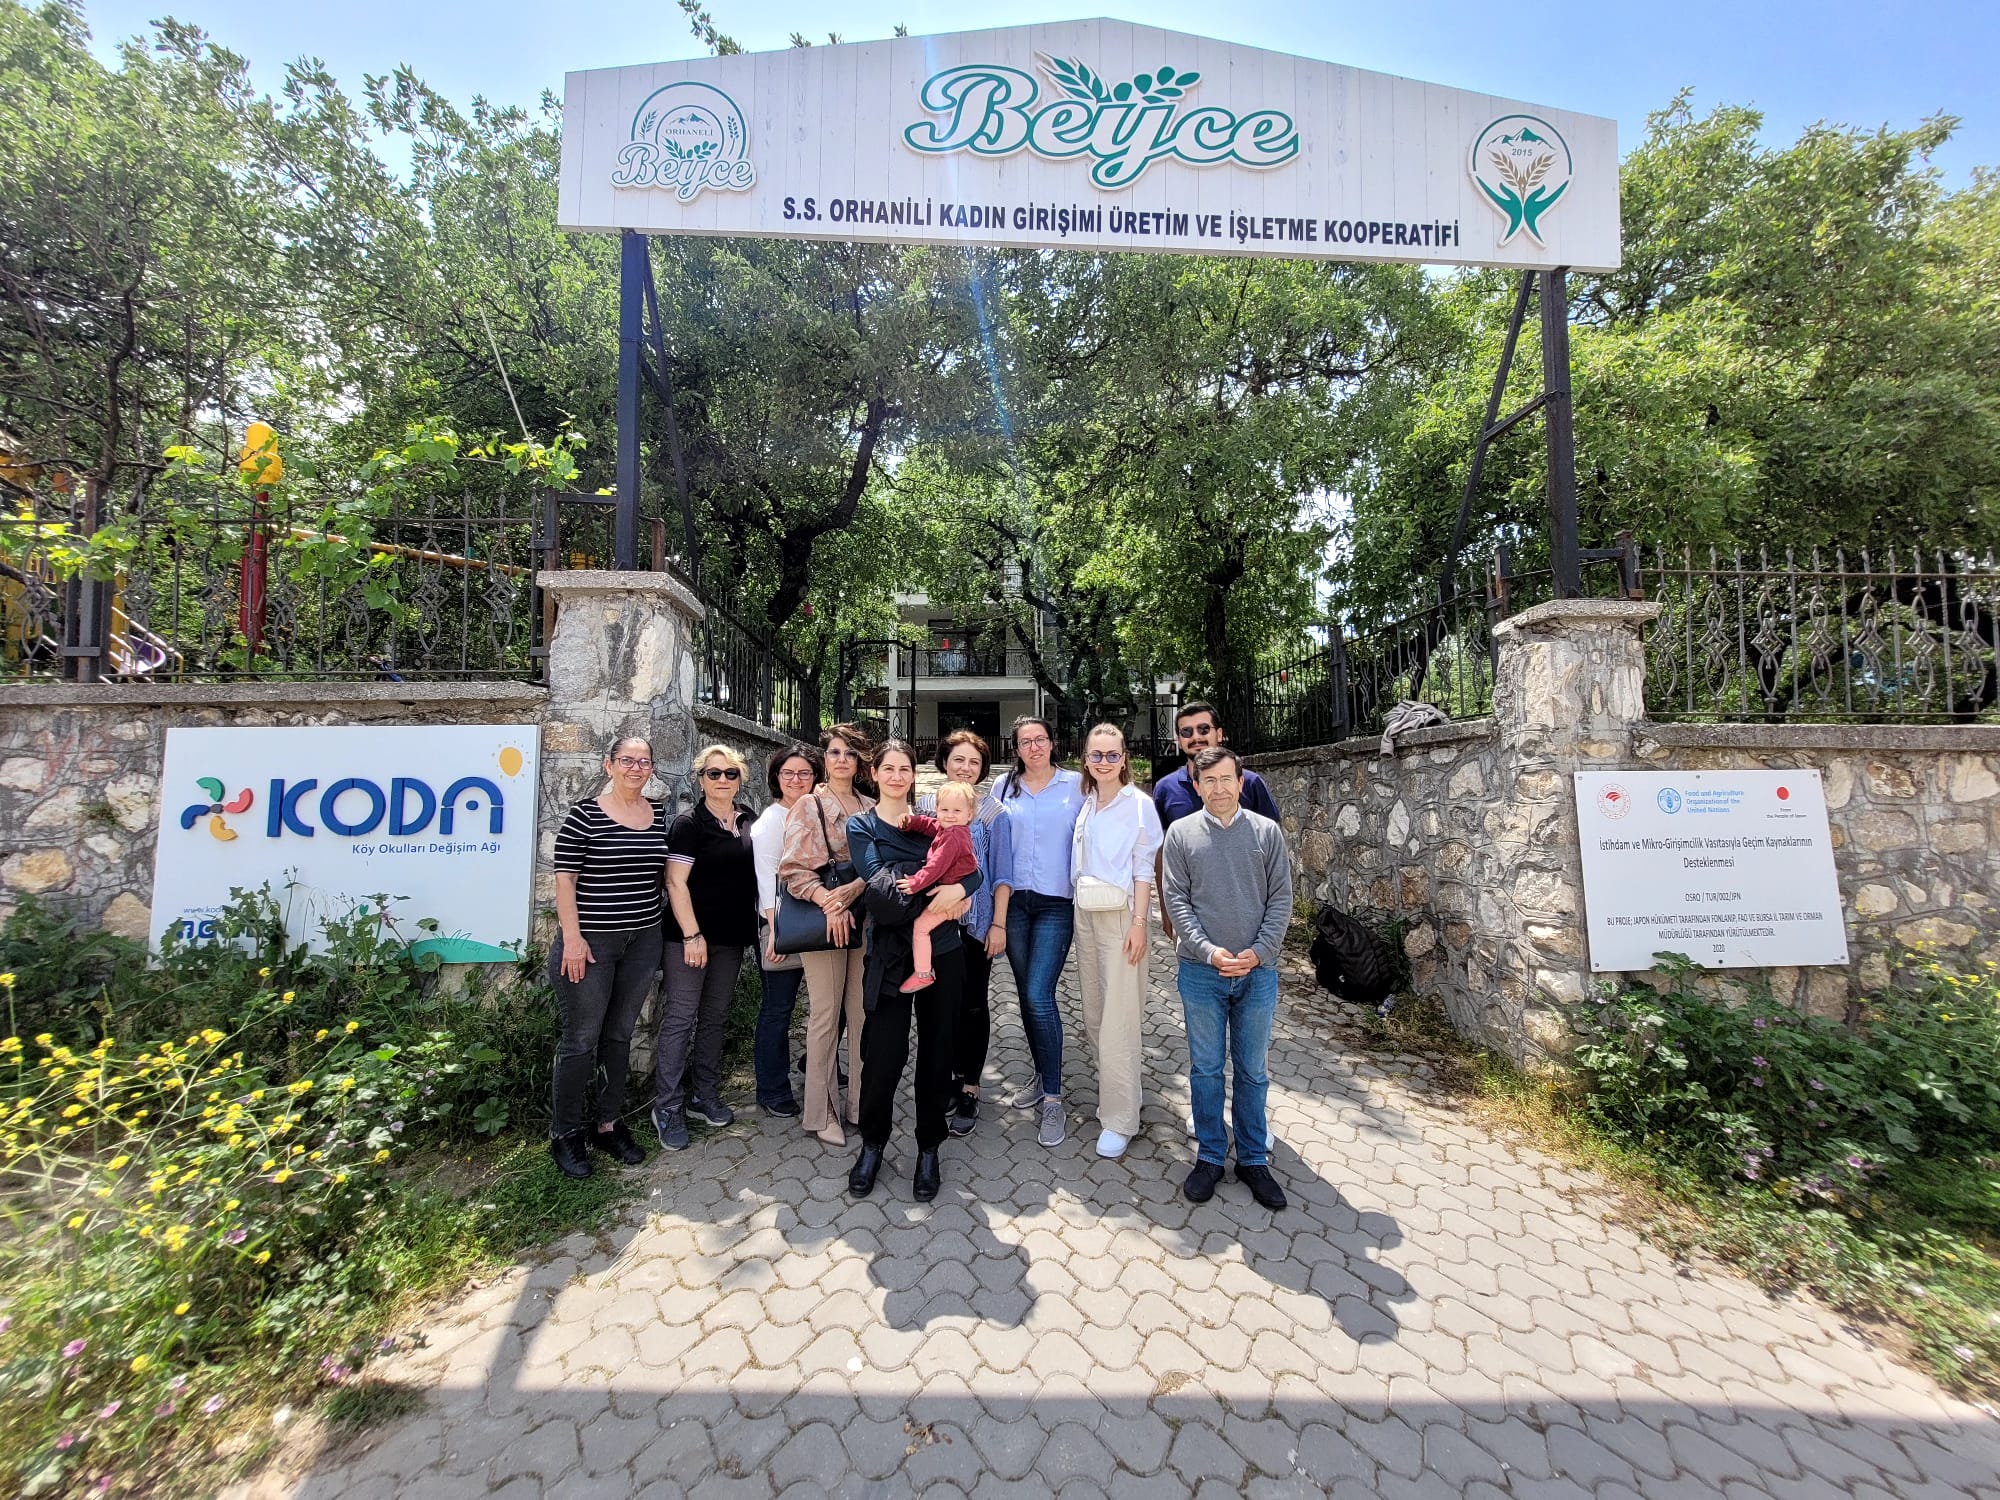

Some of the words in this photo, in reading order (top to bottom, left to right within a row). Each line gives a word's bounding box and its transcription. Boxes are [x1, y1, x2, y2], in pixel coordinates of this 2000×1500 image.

[904, 63, 1299, 187] Beyce
[665, 128, 714, 137] ORHANELİ
[1511, 148, 1533, 157] 2015
[611, 142, 753, 199] Beyce
[783, 197, 822, 221] S.S.
[829, 196, 933, 226] ORHANİLİ
[939, 203, 1006, 229] KADIN
[1013, 202, 1102, 237] GİRİŞİMİ
[1109, 205, 1189, 236] ÜRETİM
[1196, 213, 1222, 238] VE
[1229, 209, 1318, 244] İŞLETME
[1324, 218, 1460, 247] KOOPERATİFİ
[266, 776, 504, 837] KODA
[1731, 797, 1741, 805] the
[1687, 806, 1706, 814] United
[352, 843, 376, 856] Köy
[378, 842, 425, 854] Okulları
[429, 841, 477, 855] Değişim
[480, 841, 501, 855] Ağı
[1599, 837, 1630, 850] İstihdam
[1632, 840, 1641, 850] ve
[1641, 837, 1704, 851] Mikro-Girişimcilik
[1704, 836, 1741, 850] Vasıtasıyla
[1742, 836, 1765, 850] Geçim
[1765, 836, 1812, 849] Kaynaklarının
[1683, 856, 1735, 868] Desteklenmesi
[1685, 892, 1701, 902] OSRO
[1607, 917, 1615, 926] BU
[1633, 916, 1650, 926] JAPON
[1678, 914, 1711, 925] TARAFINDAN
[1737, 913, 1748, 922] FAO
[1748, 913, 1756, 922] VE
[1756, 912, 1773, 922] BURSA
[1778, 912, 1795, 921] TARIM
[1795, 912, 1802, 921] VE
[1802, 911, 1823, 921] ORMAN
[1692, 928, 1725, 938] TARAFINDAN
[1712, 943, 1725, 953] 2020
